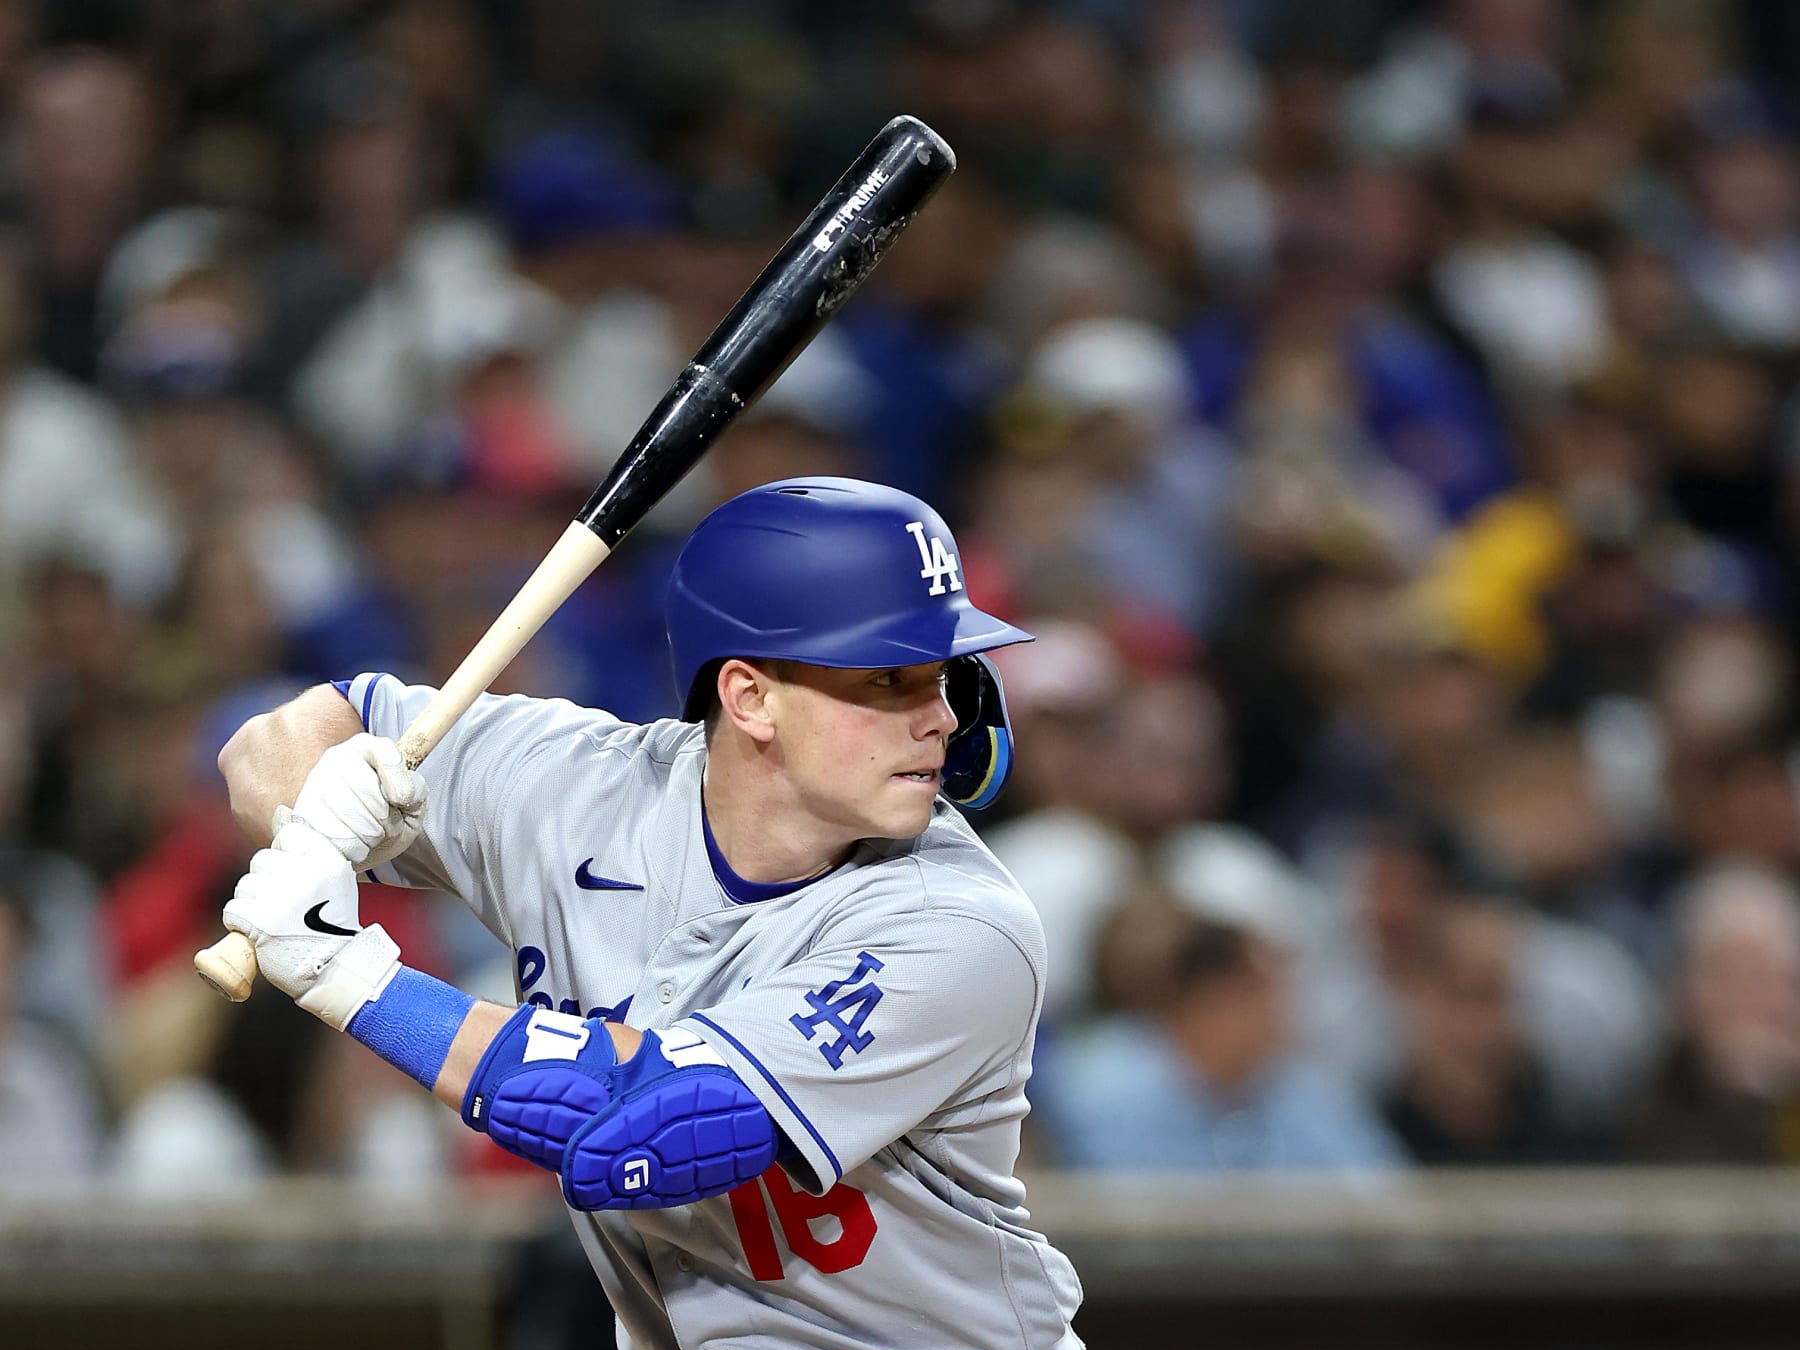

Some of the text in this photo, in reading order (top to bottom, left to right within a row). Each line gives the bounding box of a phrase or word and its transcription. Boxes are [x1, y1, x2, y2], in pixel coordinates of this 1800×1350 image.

[839, 168, 890, 221] PRIME
[905, 521, 963, 596] LA
[789, 951, 885, 1071] LA
[728, 1161, 878, 1281] 16
